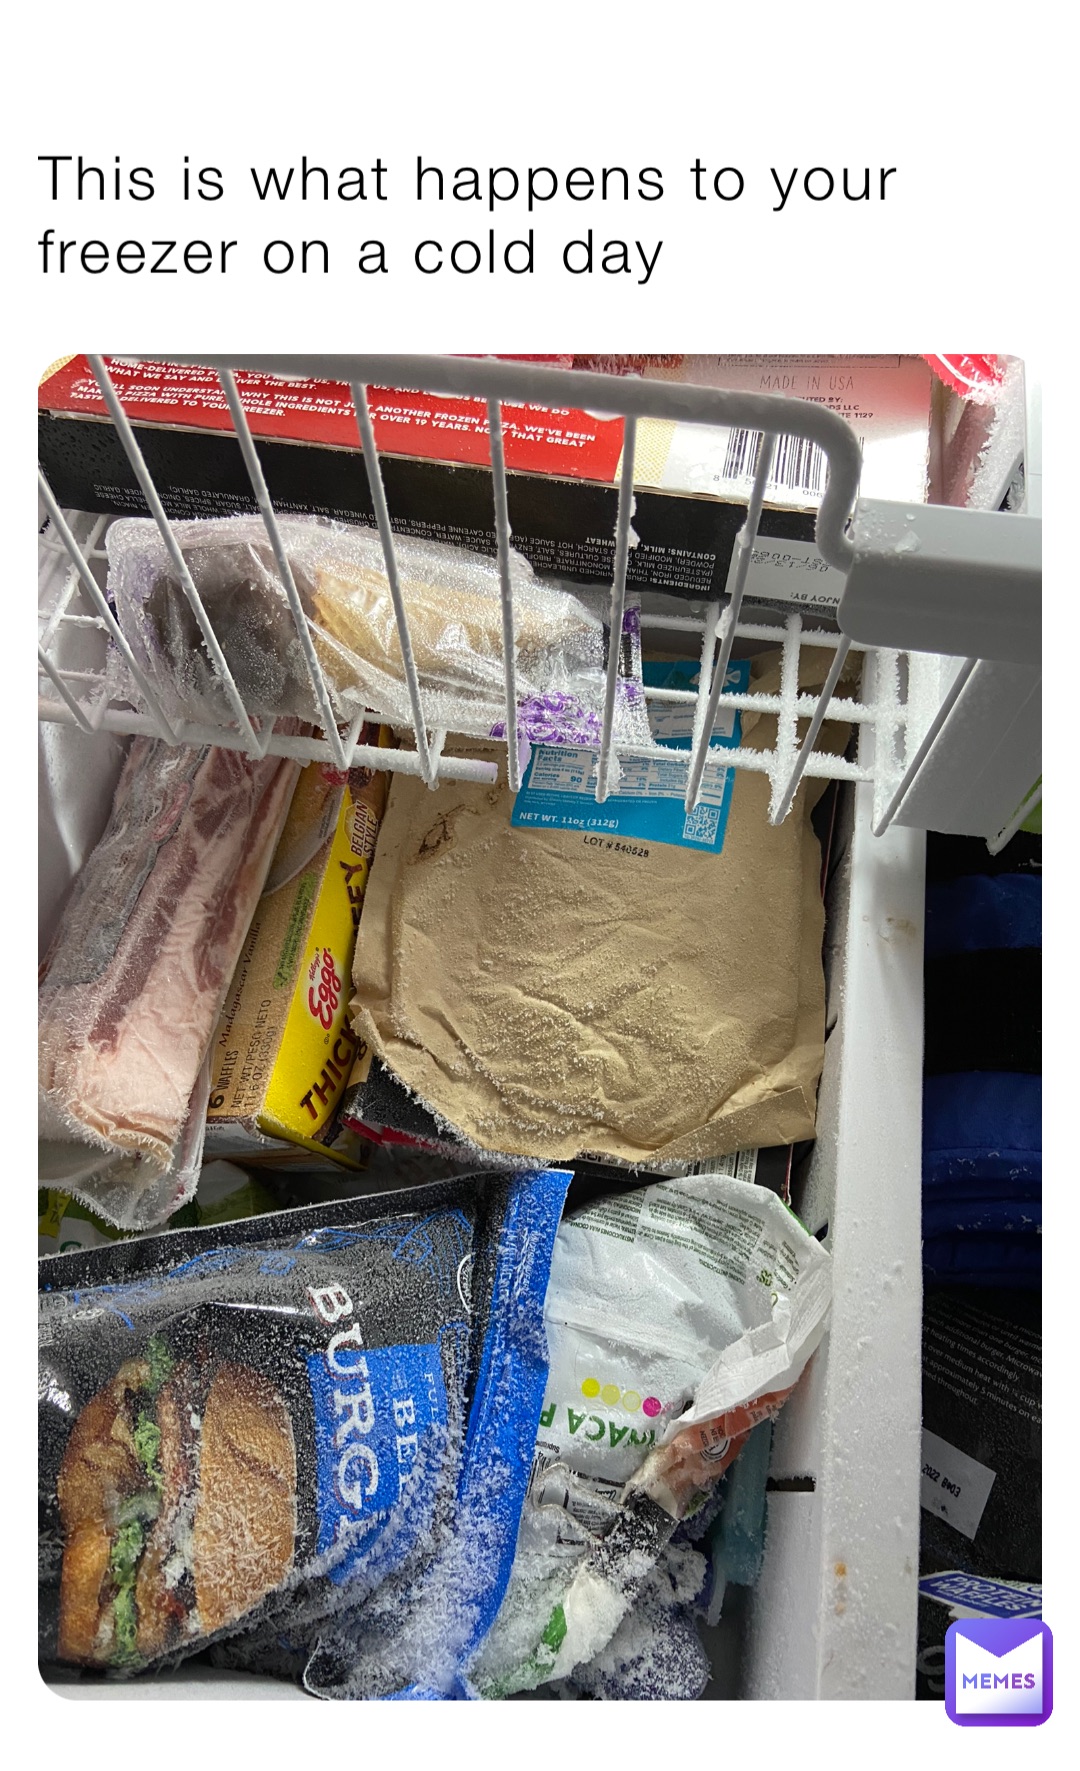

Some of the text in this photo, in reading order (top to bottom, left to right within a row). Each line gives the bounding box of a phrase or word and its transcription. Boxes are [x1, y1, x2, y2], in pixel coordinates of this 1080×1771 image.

[104, 365, 318, 390] WHAT WE SAY AND THE BEST.
[759, 374, 855, 391] MADE IN USA
[111, 358, 205, 376] HOME-DELIVERED
[247, 372, 271, 380] YOU
[528, 403, 549, 413] WE
[551, 408, 571, 416] DO
[119, 396, 179, 405] DELIVERED
[243, 404, 286, 417] REEZER.
[828, 396, 844, 404] BY:
[124, 390, 157, 398] PIZZA
[160, 391, 192, 400] WITH
[193, 393, 225, 403] PURE,
[275, 401, 352, 417] INGREDIENTS
[380, 414, 411, 425] OVER
[415, 418, 428, 426] 19
[431, 420, 472, 432] YEARS.
[510, 431, 544, 443] THAT
[546, 436, 587, 448] GREAT
[127, 384, 161, 392] SOON
[163, 385, 228, 396] UNDERSTAN
[240, 391, 271, 399] WHY
[273, 394, 299, 403] THIS
[301, 396, 313, 404] IS
[315, 398, 342, 407] NOT
[343, 401, 374, 411] JUT
[375, 405, 432, 419] ANOTHER
[433, 412, 481, 425] FROZEN
[524, 424, 563, 437] WE'VE
[565, 431, 596, 442] BEEN
[854, 412, 874, 420] 1129
[712, 474, 721, 482] 8
[93, 484, 121, 494] GARLIC
[94, 491, 125, 501] CHEESE
[201, 490, 251, 503] GRANULATED
[272, 500, 309, 511] XANTHAN
[448, 525, 484, 538] CAYENNE
[481, 546, 498, 554] OLIC
[531, 537, 556, 547] SAUCE
[557, 542, 574, 550] HOT
[584, 536, 717, 561] CONTAINS: MILK, WHEAT
[634, 551, 673, 563] MODIFIED
[651, 570, 672, 579] IRON,
[657, 563, 714, 577] (PASTEURIZED
[650, 577, 711, 591] INGREDIENTS:
[673, 574, 712, 585] REDUCED
[810, 594, 841, 605] NJOY
[539, 748, 579, 759] Nutrition
[570, 775, 583, 784] 90
[519, 811, 620, 829] NET WT. 11oz (312g)
[350, 800, 369, 858] BELGIAN
[363, 816, 379, 856] STYLE
[583, 835, 605, 848] LOT
[614, 842, 650, 858] 540528
[219, 921, 262, 1048] Madagascar Vanilla
[308, 947, 342, 1030] Eggo
[230, 1084, 245, 1109] NET
[255, 999, 272, 1032] NETO
[216, 1049, 240, 1093] WAFFLES
[208, 1094, 225, 1109] 6
[929, 1328, 957, 1349] heating
[956, 1343, 977, 1359] times
[1005, 1354, 1043, 1378] Microwav
[927, 1344, 945, 1357] over
[944, 1353, 974, 1374] medium
[974, 1368, 992, 1384] heat
[992, 1379, 1010, 1394] with
[1019, 1393, 1036, 1408] cup
[928, 1357, 1030, 1419] approximately 5 minutes on
[920, 1462, 942, 1483] 2022
